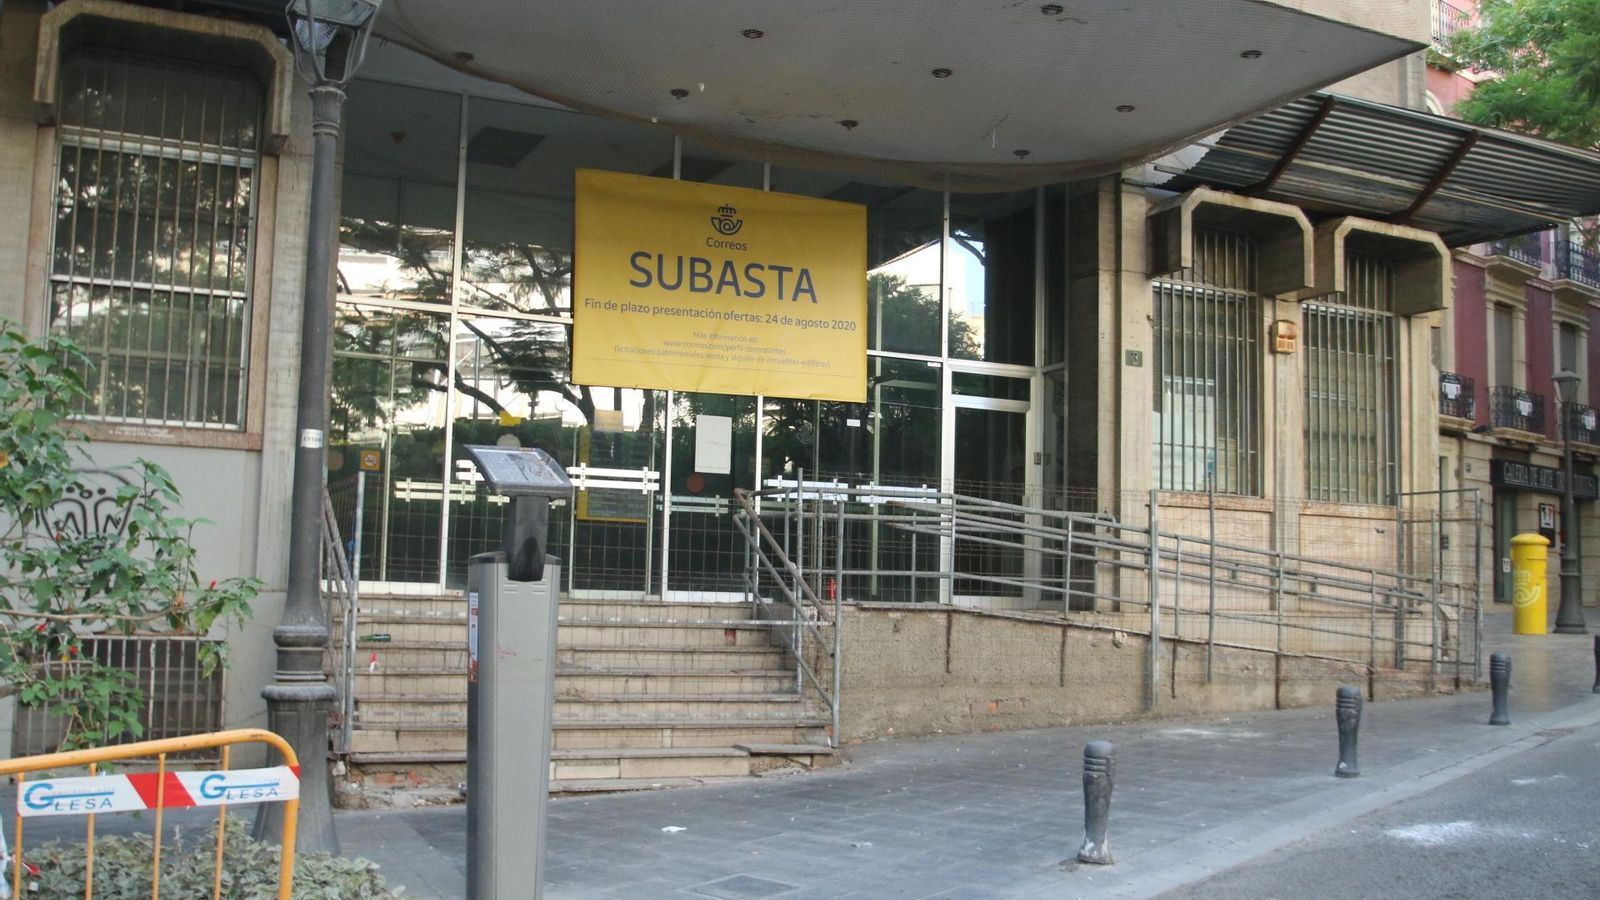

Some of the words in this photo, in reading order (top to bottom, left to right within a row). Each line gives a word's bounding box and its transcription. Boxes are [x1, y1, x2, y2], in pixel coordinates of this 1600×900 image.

[706, 236, 747, 251] Correos
[629, 251, 818, 304] SUBASTA
[584, 298, 602, 309] Fin
[604, 300, 618, 310] de
[620, 302, 650, 315] plazo
[652, 305, 722, 320] presentación
[723, 310, 763, 323] ofertas:
[765, 314, 778, 324] 24
[780, 315, 793, 326] de
[795, 318, 830, 329] agosto
[832, 320, 856, 331] 2020
[24, 783, 114, 812] GLESA
[199, 773, 279, 801] GLESA
